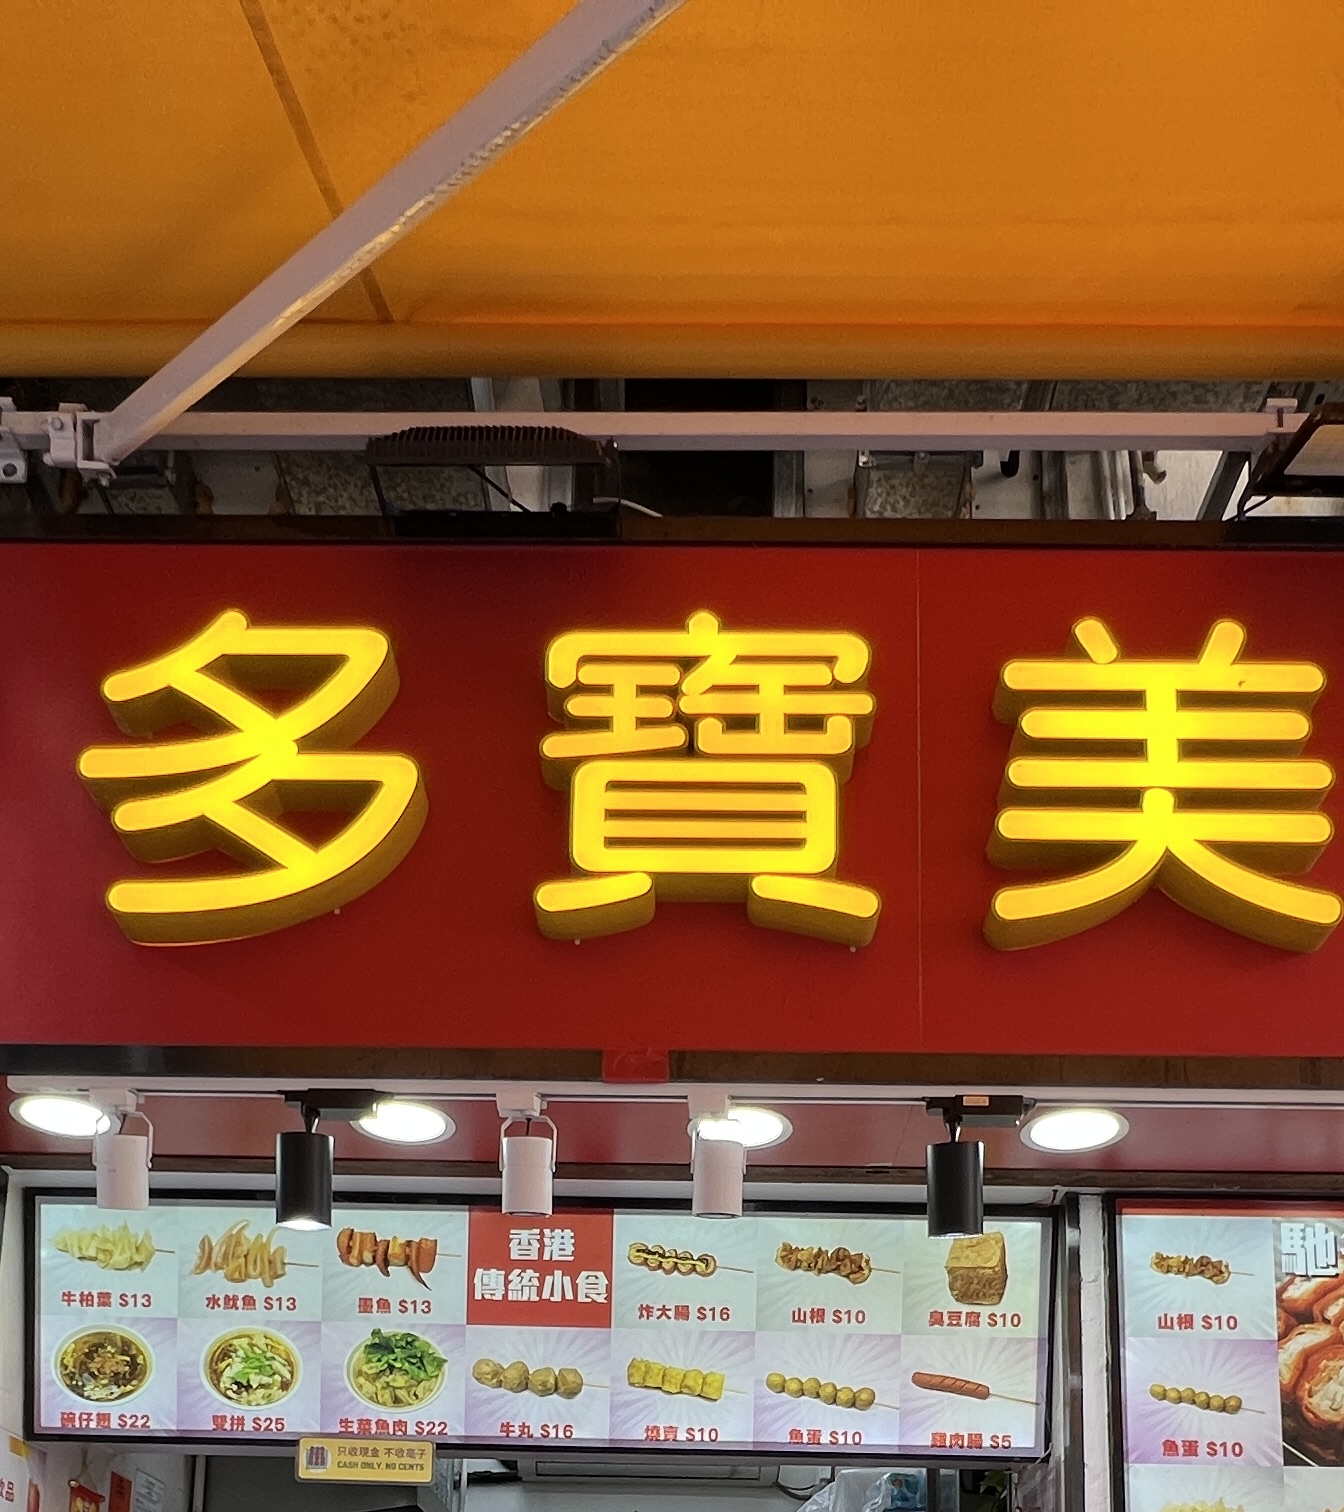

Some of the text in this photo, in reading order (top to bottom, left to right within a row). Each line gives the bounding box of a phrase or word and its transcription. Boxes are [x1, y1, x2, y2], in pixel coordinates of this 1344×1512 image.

[508, 1228, 575, 1261] 香港
[474, 1268, 609, 1303] 傳統小食
[119, 1293, 152, 1308] $13
[263, 1296, 297, 1311] $13
[398, 1299, 432, 1314] $13
[638, 1304, 731, 1321] 炸大腸 $16
[791, 1307, 866, 1324] 山根 $10
[928, 1310, 1022, 1328] 臭豆腐 $10
[1157, 1313, 1238, 1331] 山根 $10
[117, 1414, 151, 1429] $22
[252, 1417, 286, 1432] $25
[338, 1418, 448, 1436] 生菜魚肉 $22
[499, 1422, 574, 1438] 牛丸 $16
[644, 1425, 719, 1442] 燒賣 $10
[788, 1428, 863, 1446] 魚蛋 $10
[989, 1435, 1012, 1450] $5
[1162, 1439, 1244, 1457] 魚蛋 $10
[337, 1446, 427, 1460] 只收現金 不收毫子
[337, 1461, 359, 1469] CASH
[398, 1463, 425, 1471] CENTS
